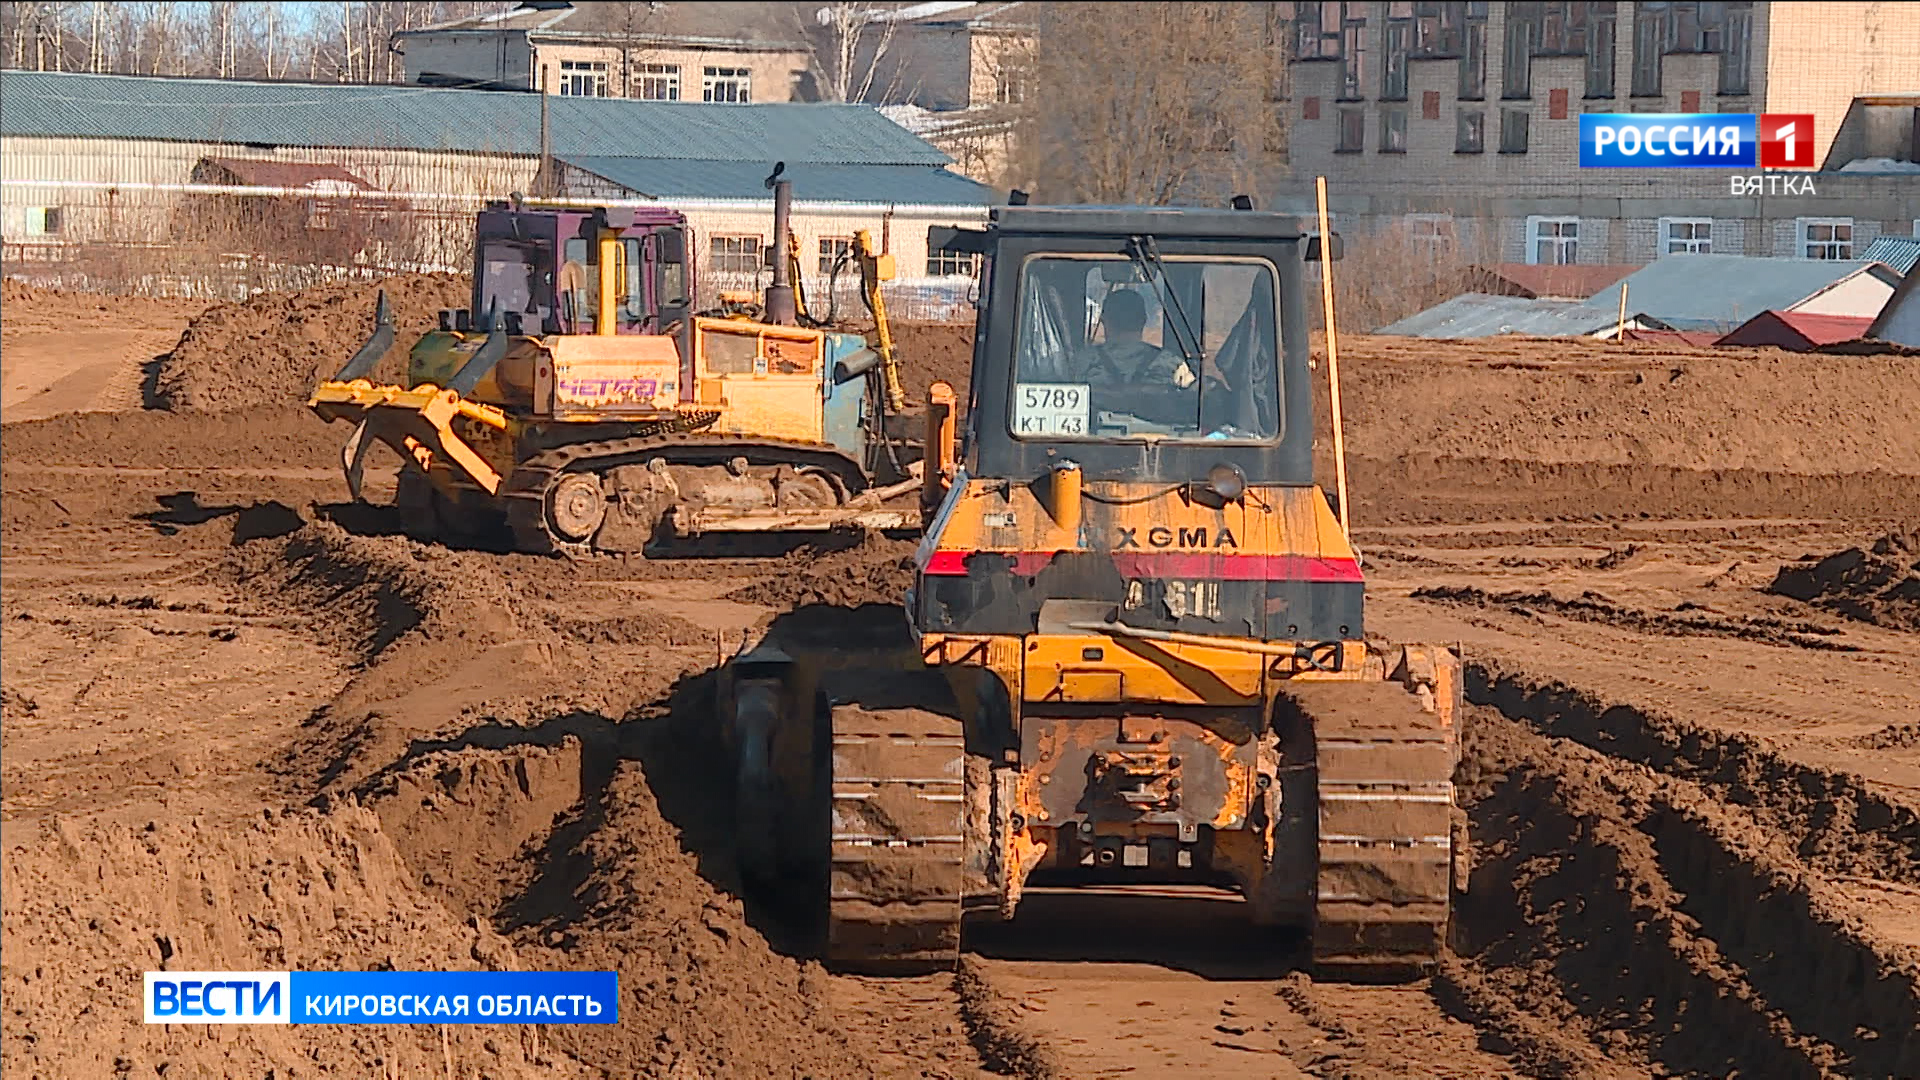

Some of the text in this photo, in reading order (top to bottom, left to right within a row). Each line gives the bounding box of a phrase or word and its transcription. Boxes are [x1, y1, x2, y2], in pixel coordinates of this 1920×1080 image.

[1025, 387, 1080, 409] 5789
[1060, 417, 1082, 434] 43
[1117, 526, 1238, 549] XGMA
